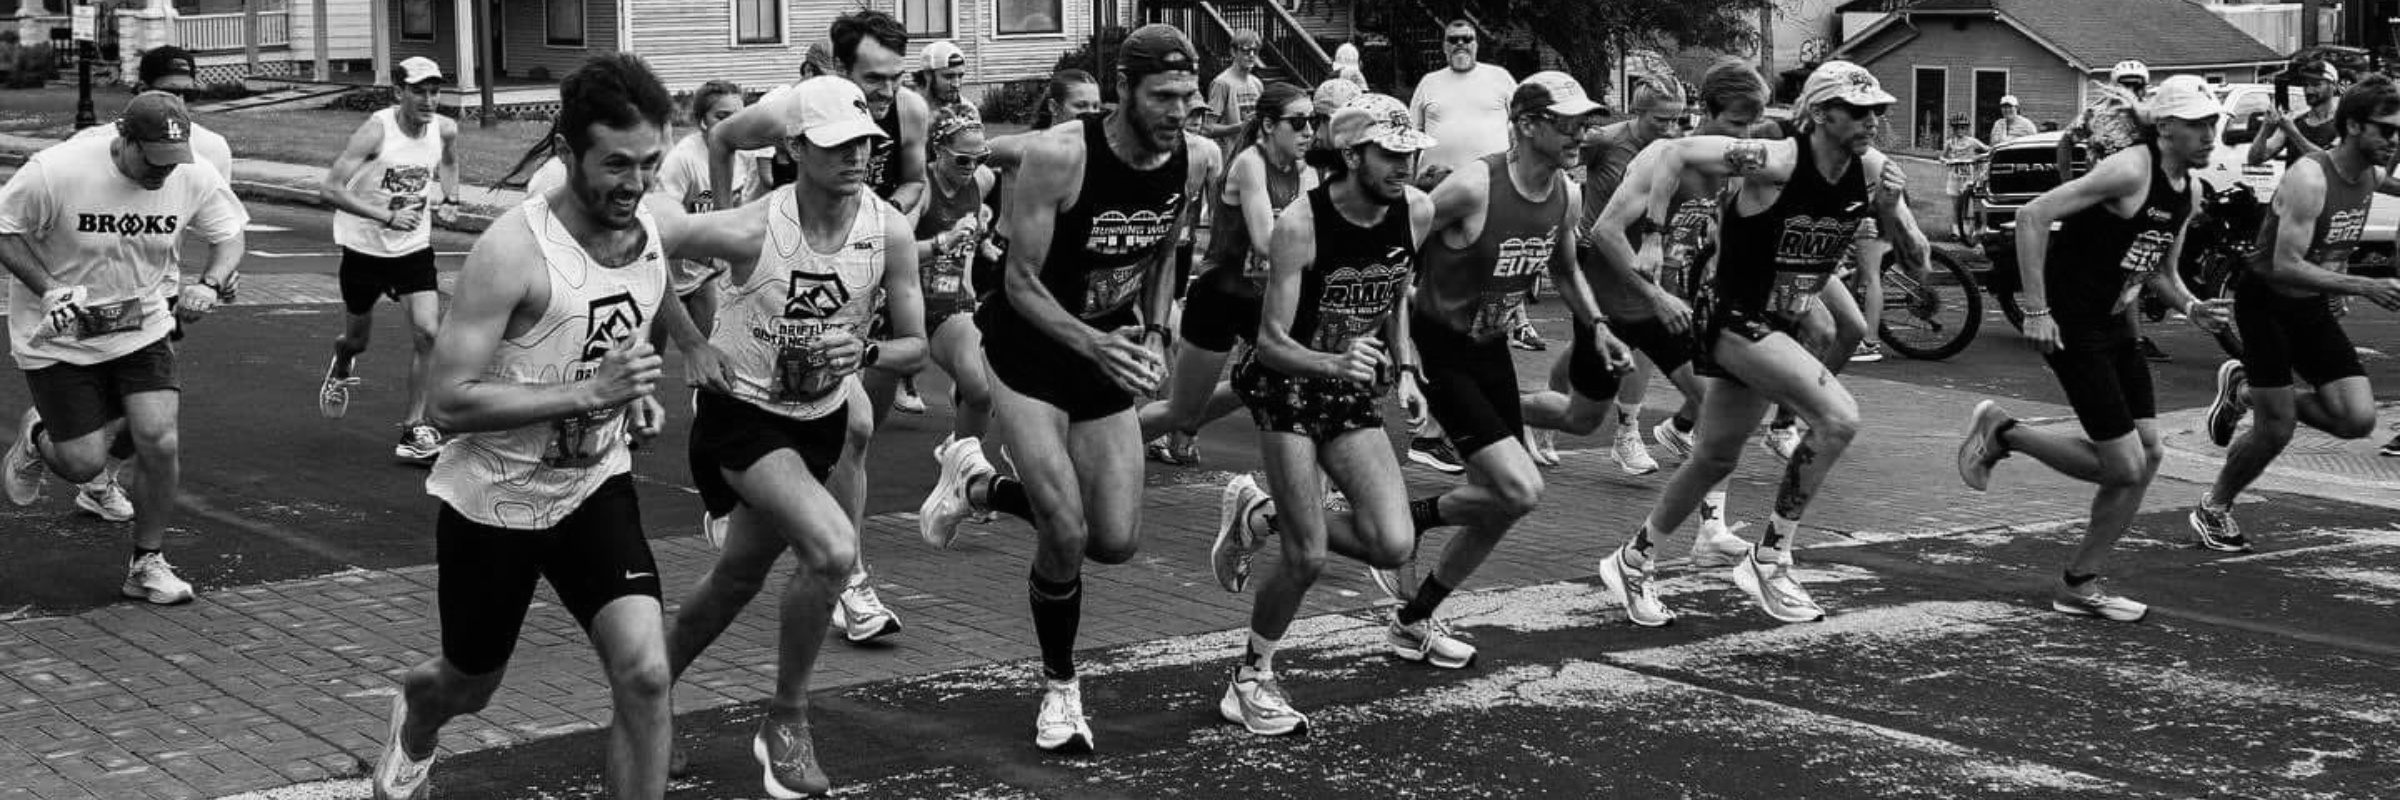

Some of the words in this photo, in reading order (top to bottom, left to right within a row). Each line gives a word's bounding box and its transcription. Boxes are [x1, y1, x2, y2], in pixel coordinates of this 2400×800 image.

[77, 212, 178, 236] BROOKS
[1778, 230, 1843, 257] RW
[1320, 281, 1395, 306] RW
